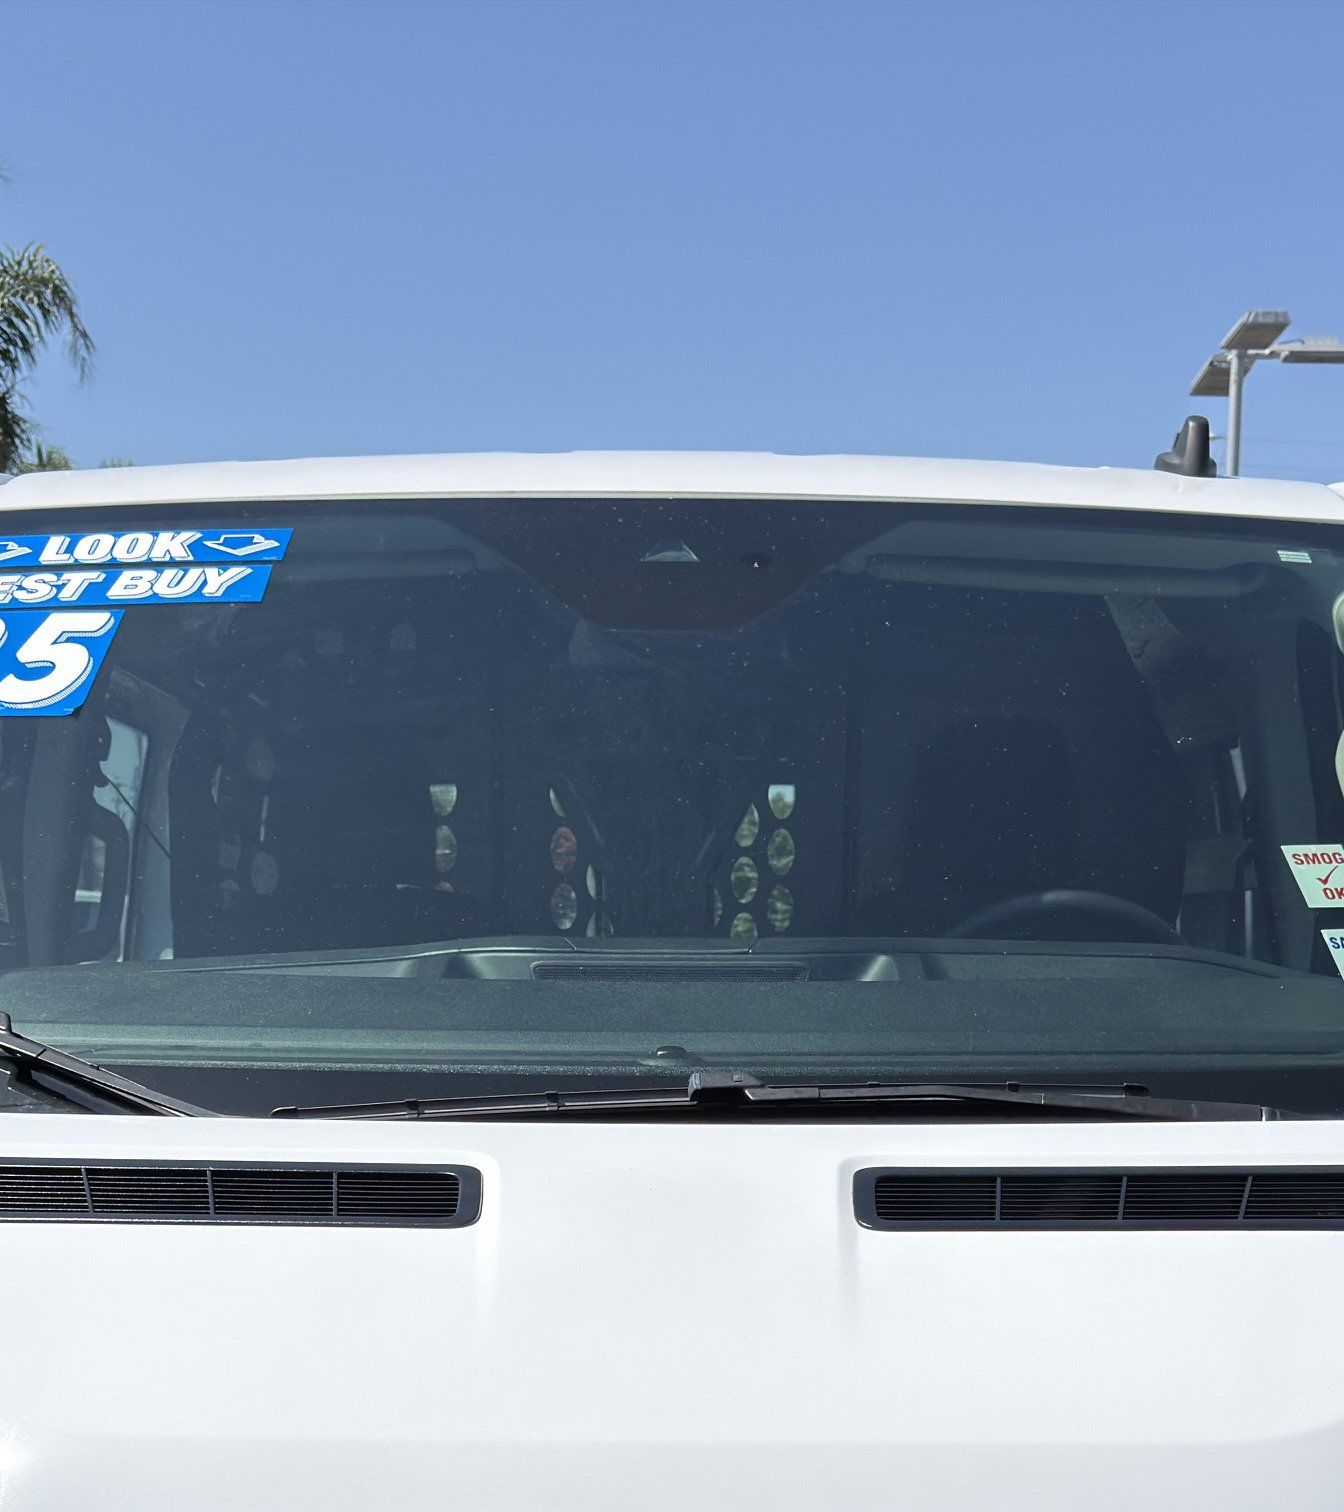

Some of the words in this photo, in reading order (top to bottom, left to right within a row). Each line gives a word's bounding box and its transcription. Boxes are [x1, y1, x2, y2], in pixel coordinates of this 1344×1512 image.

[39, 531, 204, 564] LOOK
[106, 565, 254, 599] BUY
[1292, 852, 1344, 866] SMOG
